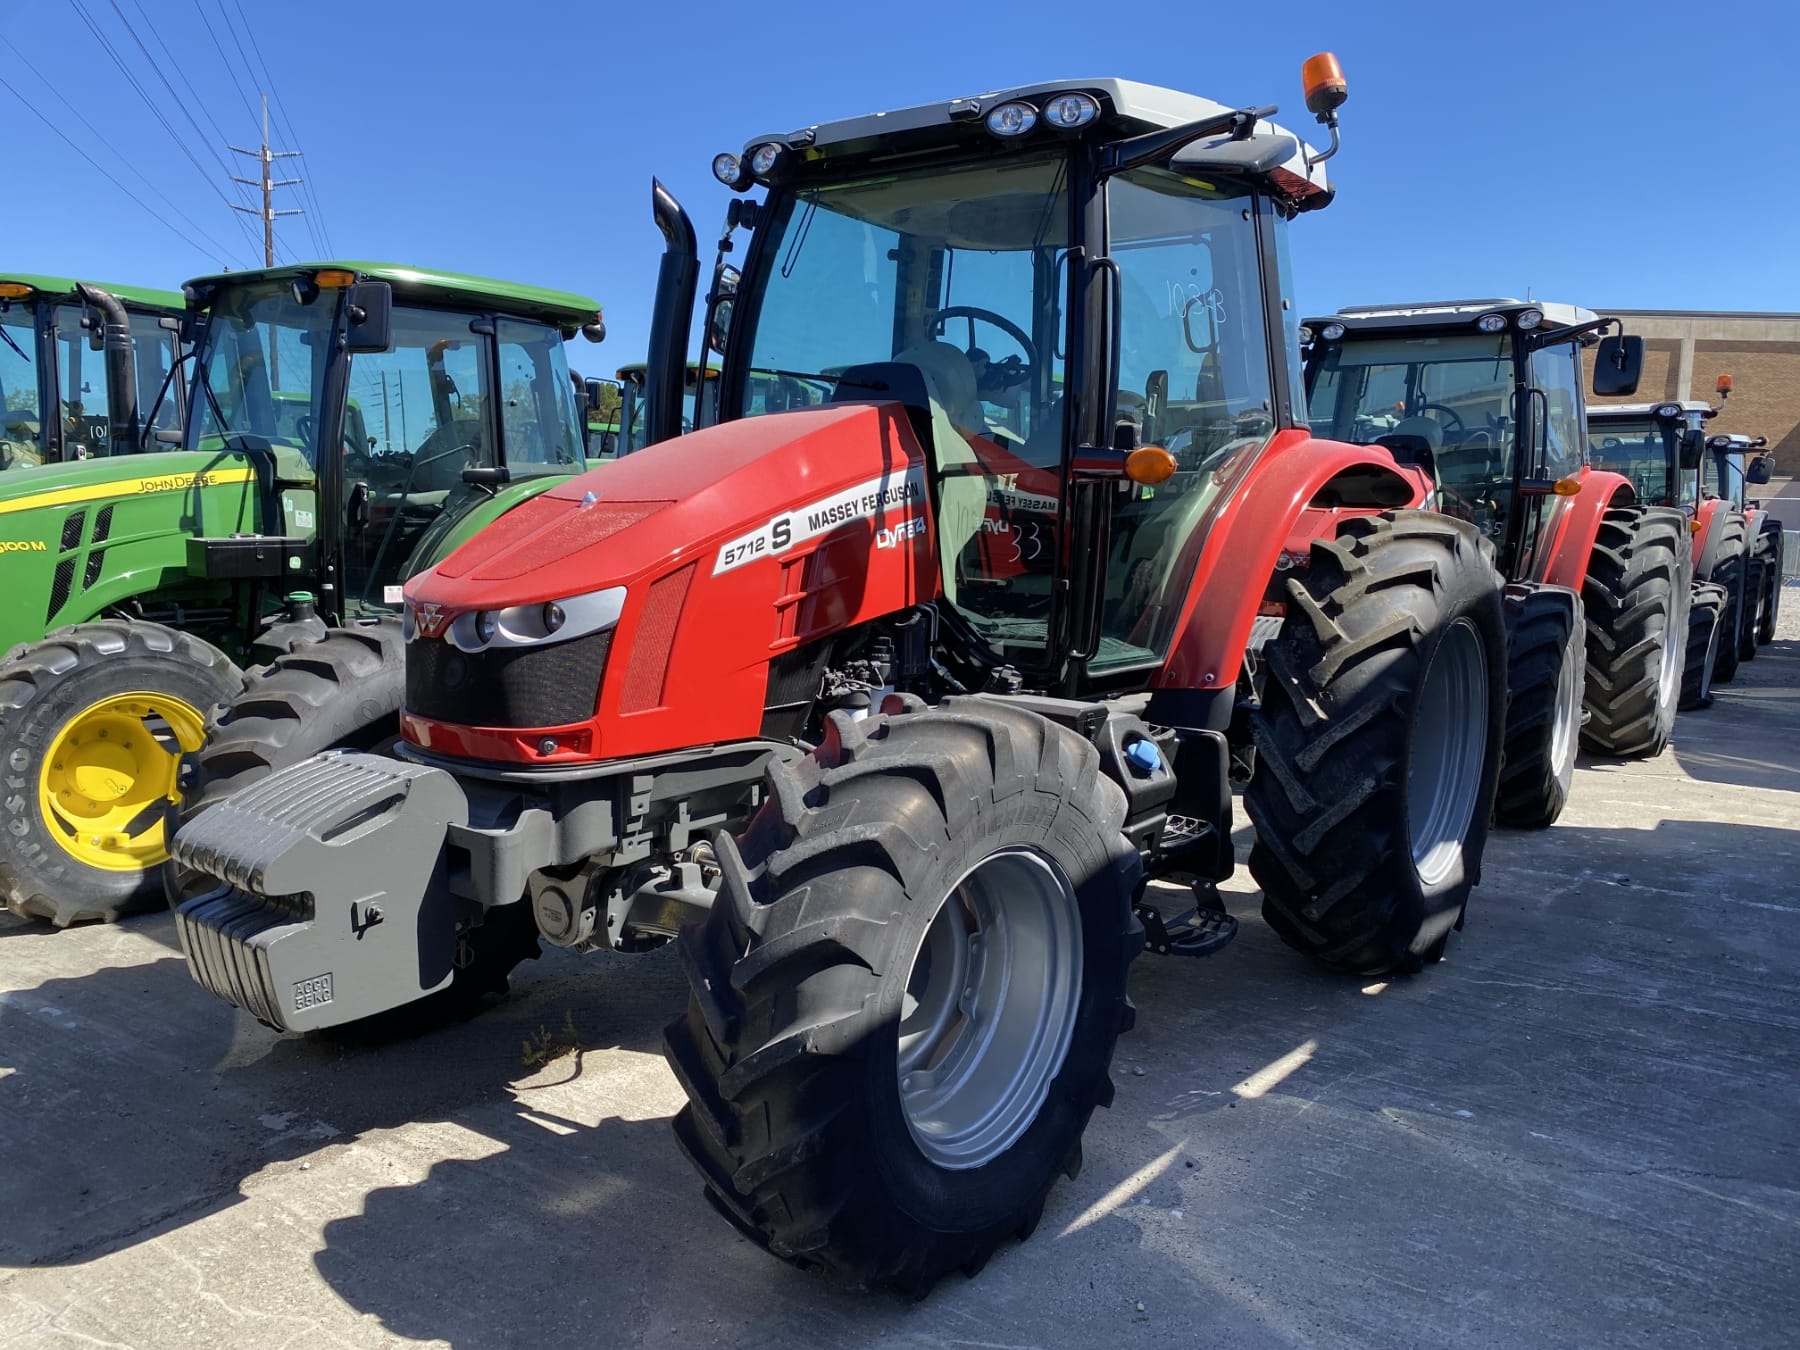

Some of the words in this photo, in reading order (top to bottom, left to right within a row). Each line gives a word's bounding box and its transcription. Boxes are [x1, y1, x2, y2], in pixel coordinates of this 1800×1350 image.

[138, 480, 174, 493] JOHN
[175, 475, 216, 489] DEERE
[807, 500, 859, 532] MASSEY
[862, 482, 919, 512] FERGUSON
[724, 537, 765, 565] 5712
[772, 519, 791, 550] S
[296, 976, 330, 998] AGCO
[296, 989, 331, 1010] 55KG
